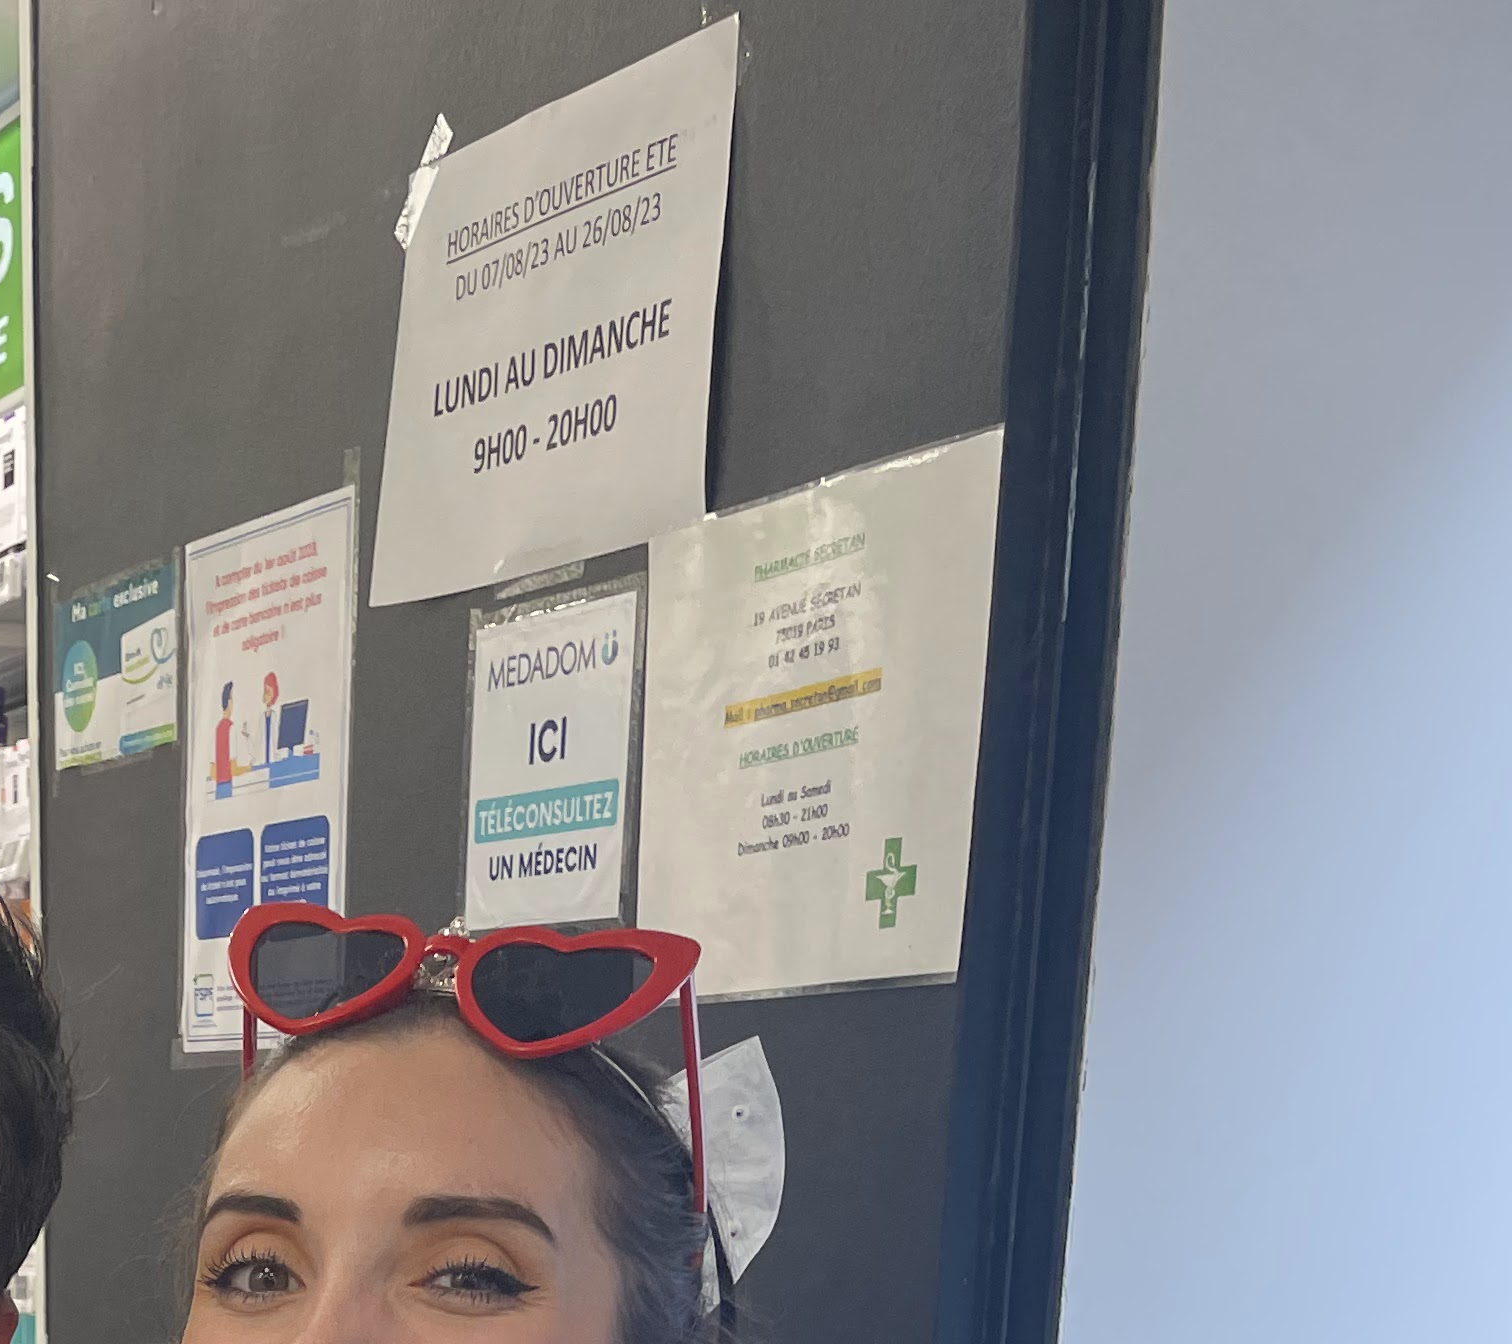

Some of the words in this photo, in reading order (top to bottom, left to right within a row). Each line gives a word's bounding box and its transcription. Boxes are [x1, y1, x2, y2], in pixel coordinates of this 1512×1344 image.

[447, 202, 519, 258] HORAIRES
[524, 148, 640, 224] D'OUVERTURE
[646, 133, 678, 171] ETE
[456, 269, 477, 300] DU
[481, 238, 549, 289] 07/08/23
[554, 226, 577, 260] AU
[582, 192, 661, 248] 26/08/23
[434, 362, 499, 418] LUNDI
[505, 349, 536, 394] AU
[543, 298, 673, 380] DIMANCHE
[473, 424, 527, 475] 9H00
[546, 394, 618, 451] 20H00
[487, 638, 596, 692] MEDADOM
[528, 716, 568, 765] ICI
[479, 790, 614, 837] TÉLÉCONSULTEZ
[488, 854, 514, 882] UN
[518, 842, 598, 878] MÉDECIN
